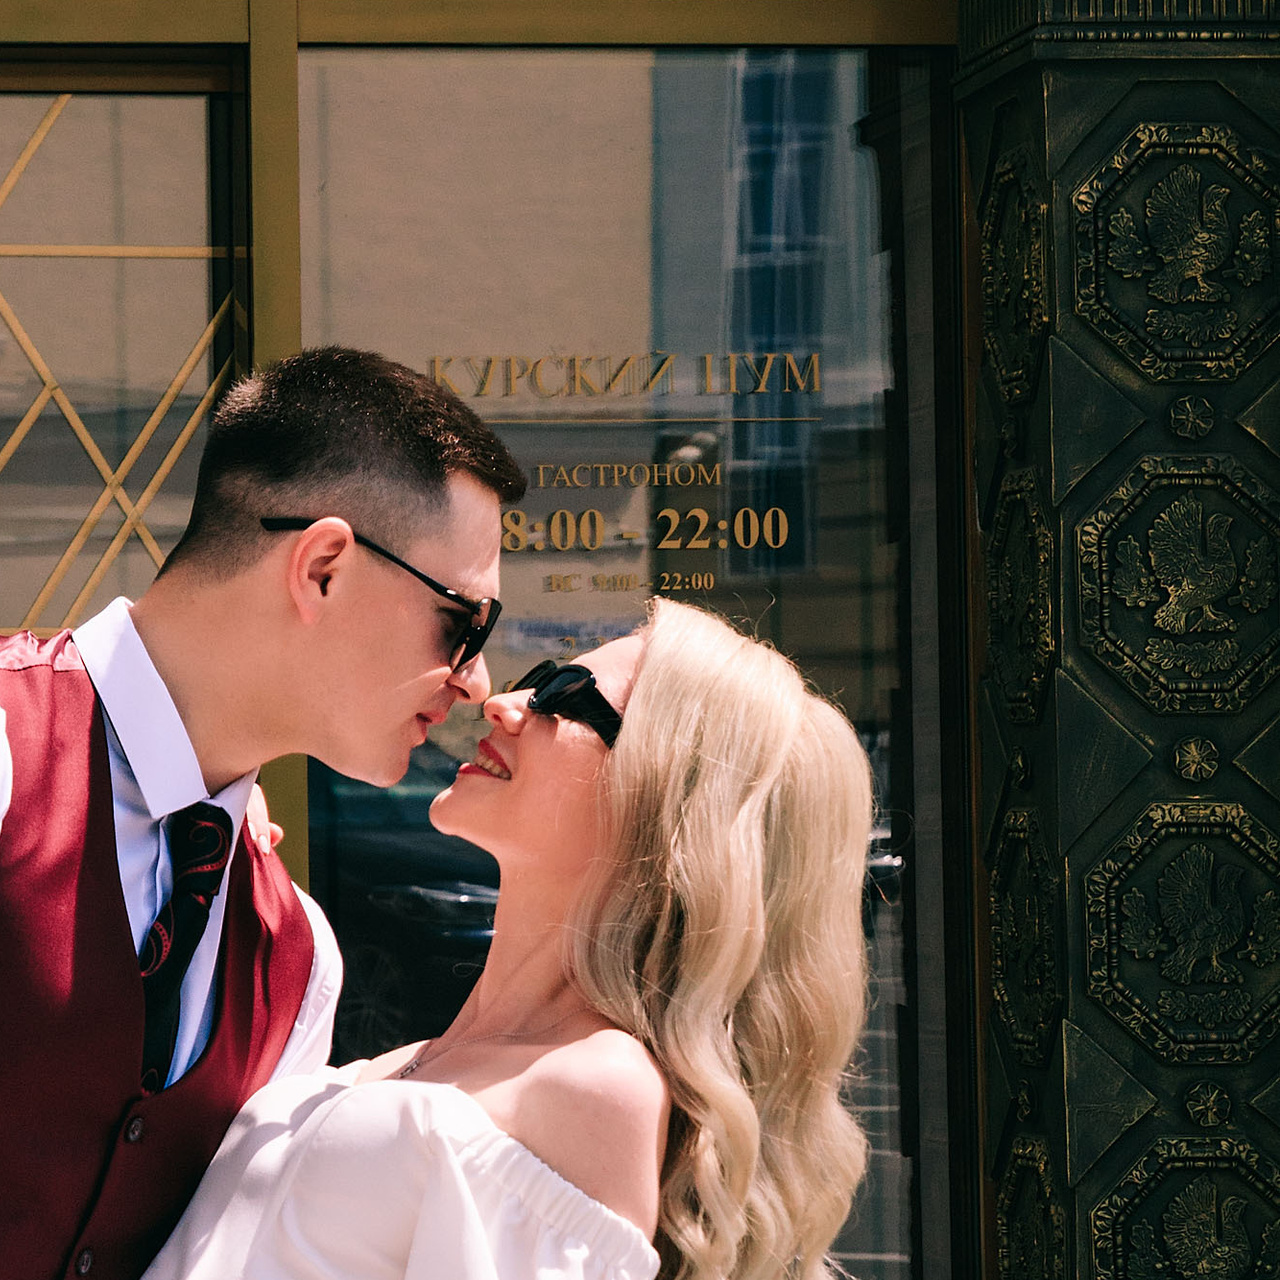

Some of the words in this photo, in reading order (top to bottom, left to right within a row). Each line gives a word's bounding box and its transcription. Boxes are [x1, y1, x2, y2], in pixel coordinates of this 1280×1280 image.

[431, 349, 678, 396] КУРСКИЙ
[704, 352, 820, 394] ЦУМ
[537, 462, 721, 488] ГАСТРОНОМ
[501, 509, 605, 551] 8:00
[656, 507, 789, 550] 22:00
[660, 572, 715, 591] 22:00
